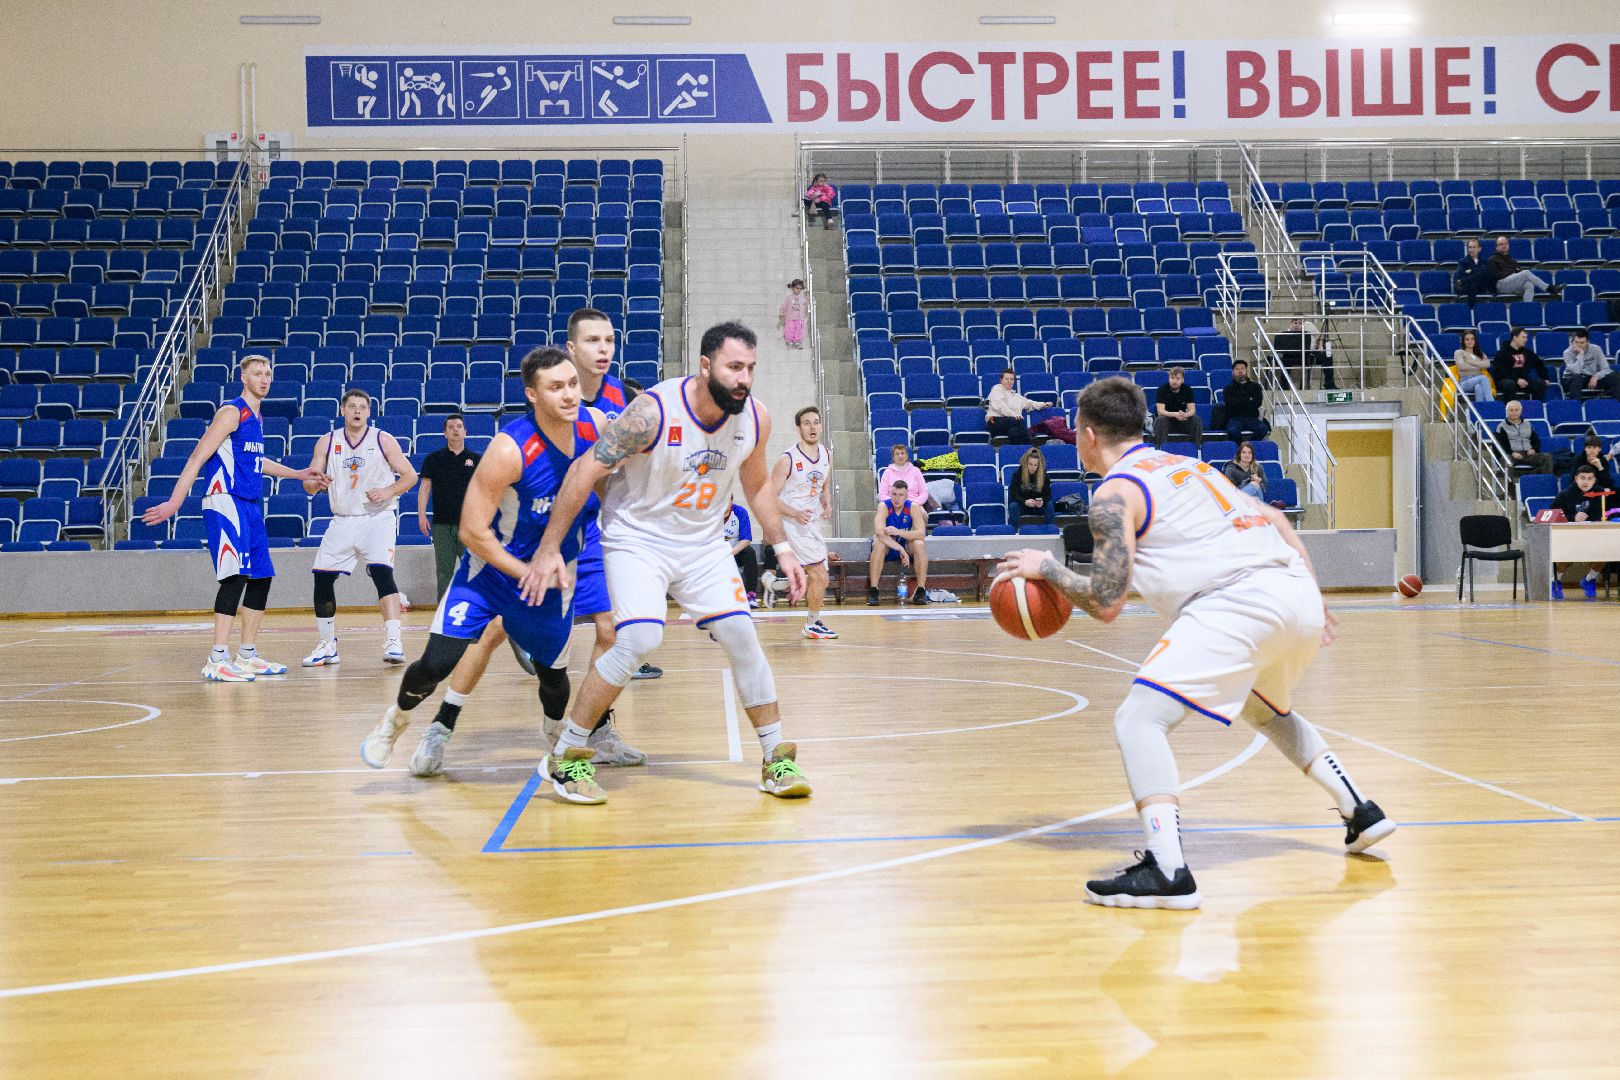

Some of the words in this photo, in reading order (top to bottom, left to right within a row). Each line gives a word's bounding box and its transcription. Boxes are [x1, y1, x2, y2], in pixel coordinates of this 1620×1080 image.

[786, 51, 1186, 122] БЫСТРЕЕ!
[1226, 46, 1496, 118] ВЫШЕ!
[1536, 43, 1620, 113] С
[350, 473, 359, 490] 7
[673, 482, 718, 511] 28
[448, 601, 470, 627] 4
